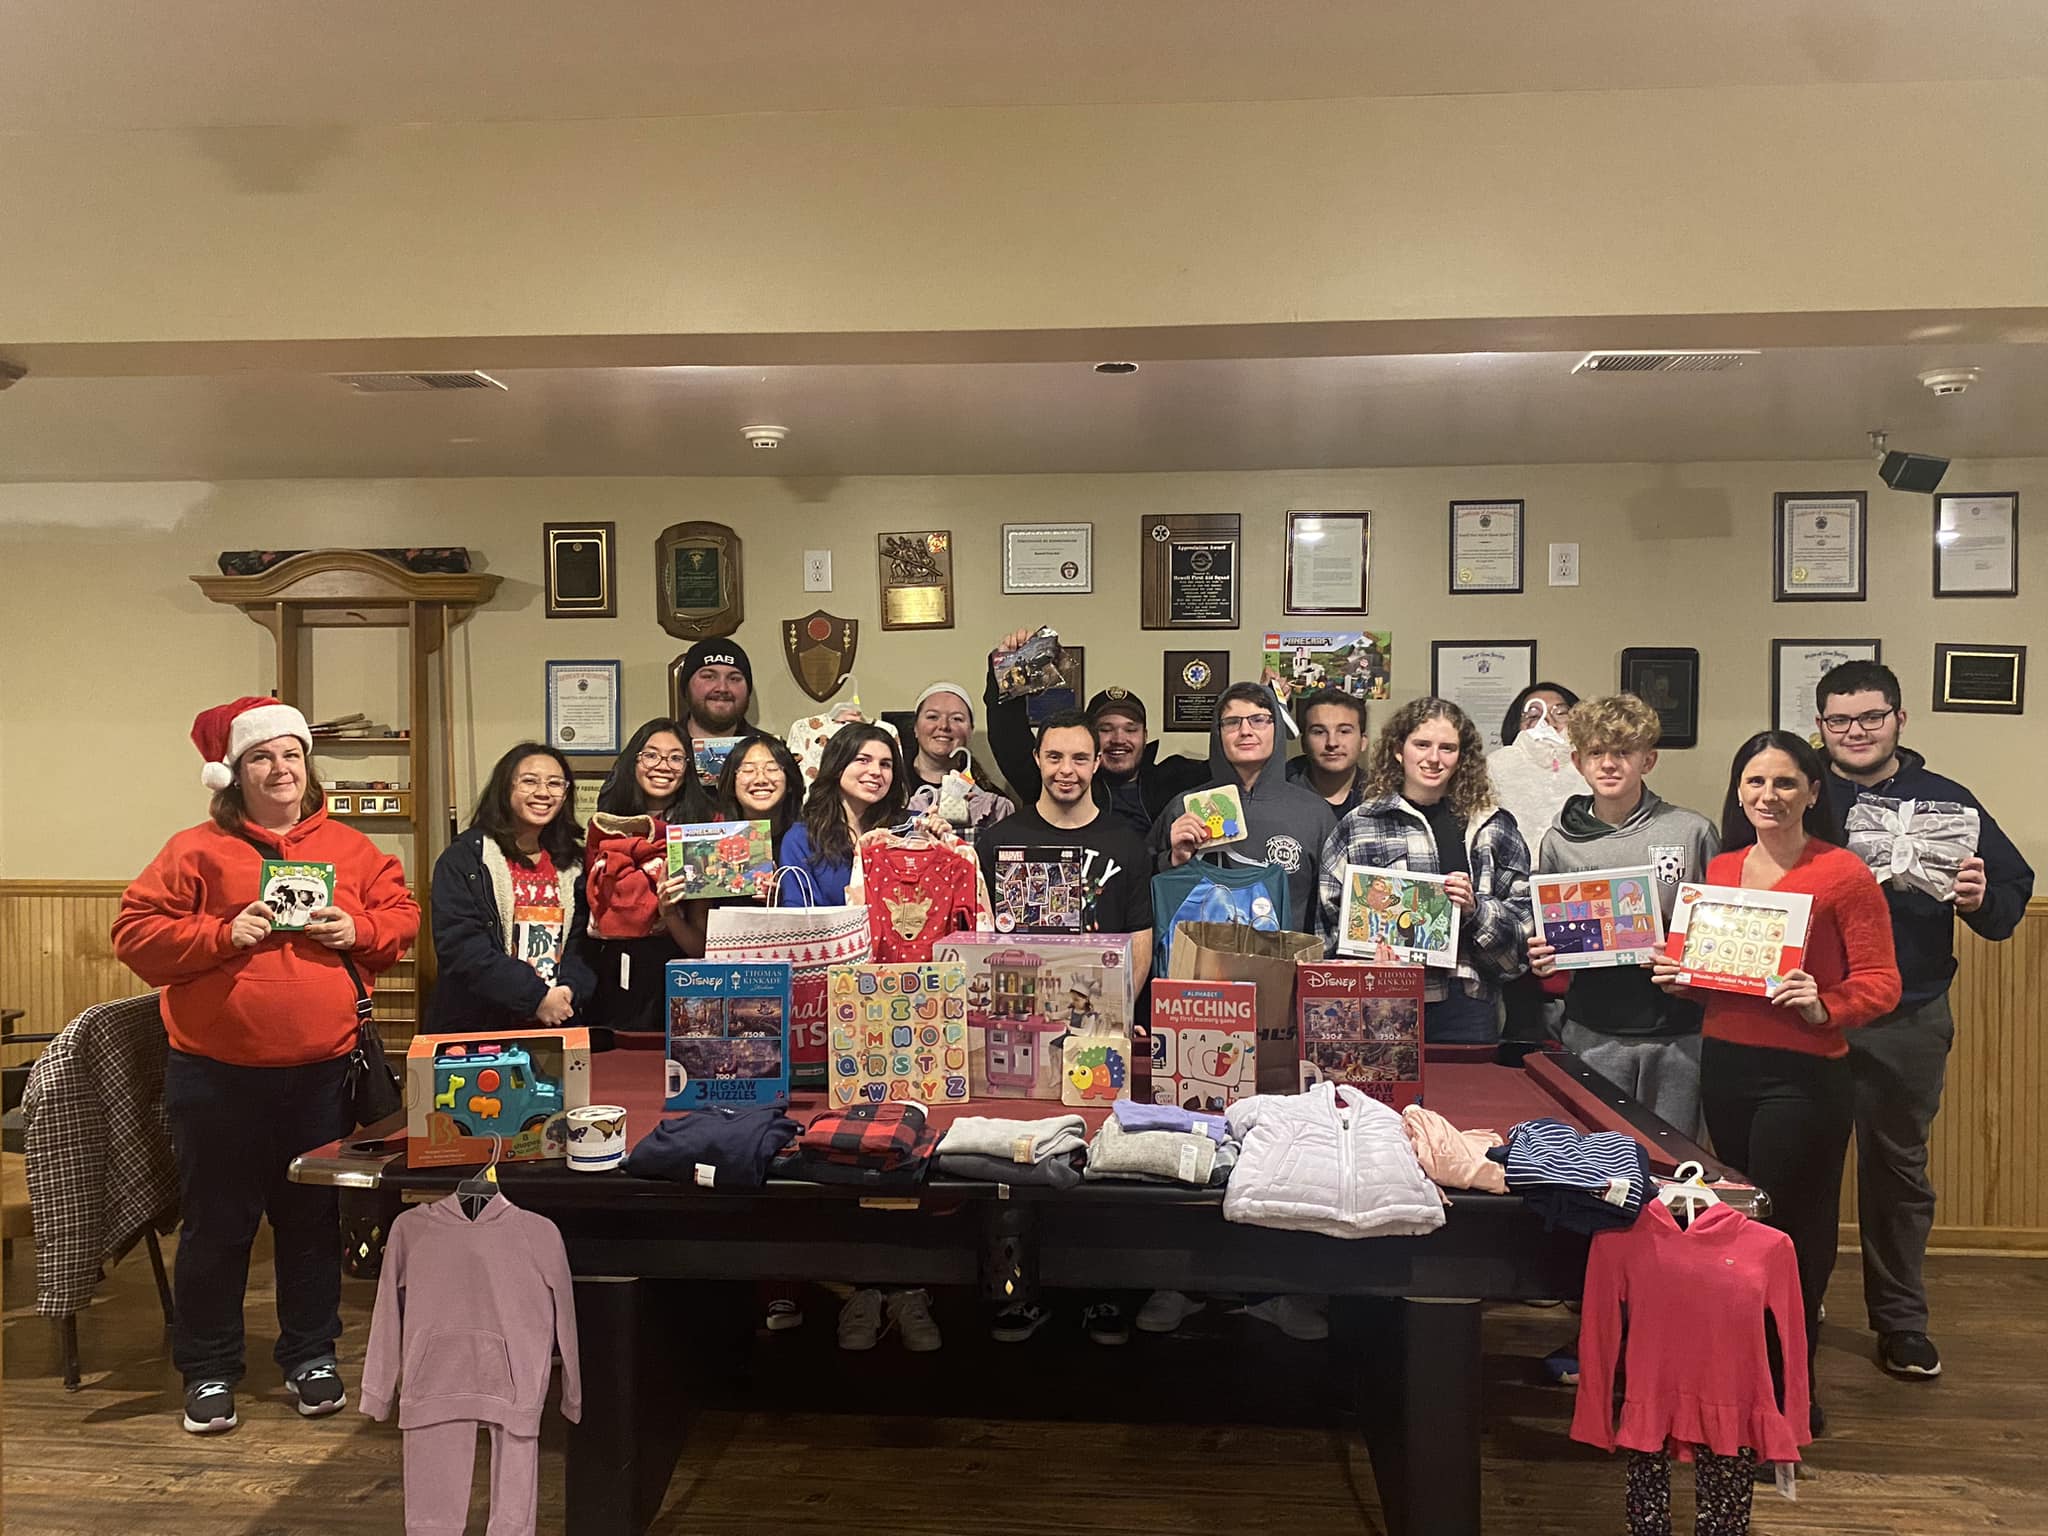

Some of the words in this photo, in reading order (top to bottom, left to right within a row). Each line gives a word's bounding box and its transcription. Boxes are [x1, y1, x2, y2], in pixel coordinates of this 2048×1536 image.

[1283, 637, 1333, 646] MINECRAFT
[704, 654, 735, 665] RAB
[998, 850, 1024, 861] MARVEL
[670, 969, 723, 991] Disney
[835, 974, 854, 994] A
[858, 972, 877, 995] B
[881, 972, 899, 994] C
[901, 972, 920, 993] D
[924, 972, 939, 992] E
[944, 970, 964, 992] F
[1303, 970, 1357, 992] Disney
[1377, 971, 1417, 979] THOMAS
[1377, 978, 1416, 986] KINKADE
[838, 1001, 856, 1021] G
[865, 1001, 884, 1020] H
[892, 998, 910, 1020] I
[918, 998, 937, 1019] J
[944, 998, 963, 1019] K
[1155, 998, 1251, 1018] MATCHING
[833, 1029, 853, 1050] L
[865, 1031, 884, 1048] M
[892, 1026, 912, 1048] N
[920, 1025, 939, 1046] O
[945, 1022, 963, 1044] P
[1200, 1034, 1206, 1042] A
[837, 1055, 858, 1076] Q
[867, 1054, 886, 1076] R
[893, 1055, 911, 1075] S
[918, 1054, 935, 1074] T
[945, 1048, 964, 1070] U
[696, 1081, 708, 1100] 3
[710, 1081, 756, 1091] JIGSAW
[710, 1090, 757, 1100] PUZZLES
[835, 1085, 856, 1104] V
[867, 1082, 886, 1102] W
[890, 1080, 909, 1101] X
[922, 1081, 938, 1099] Y
[946, 1076, 966, 1098] Z
[1182, 1082, 1188, 1090] d
